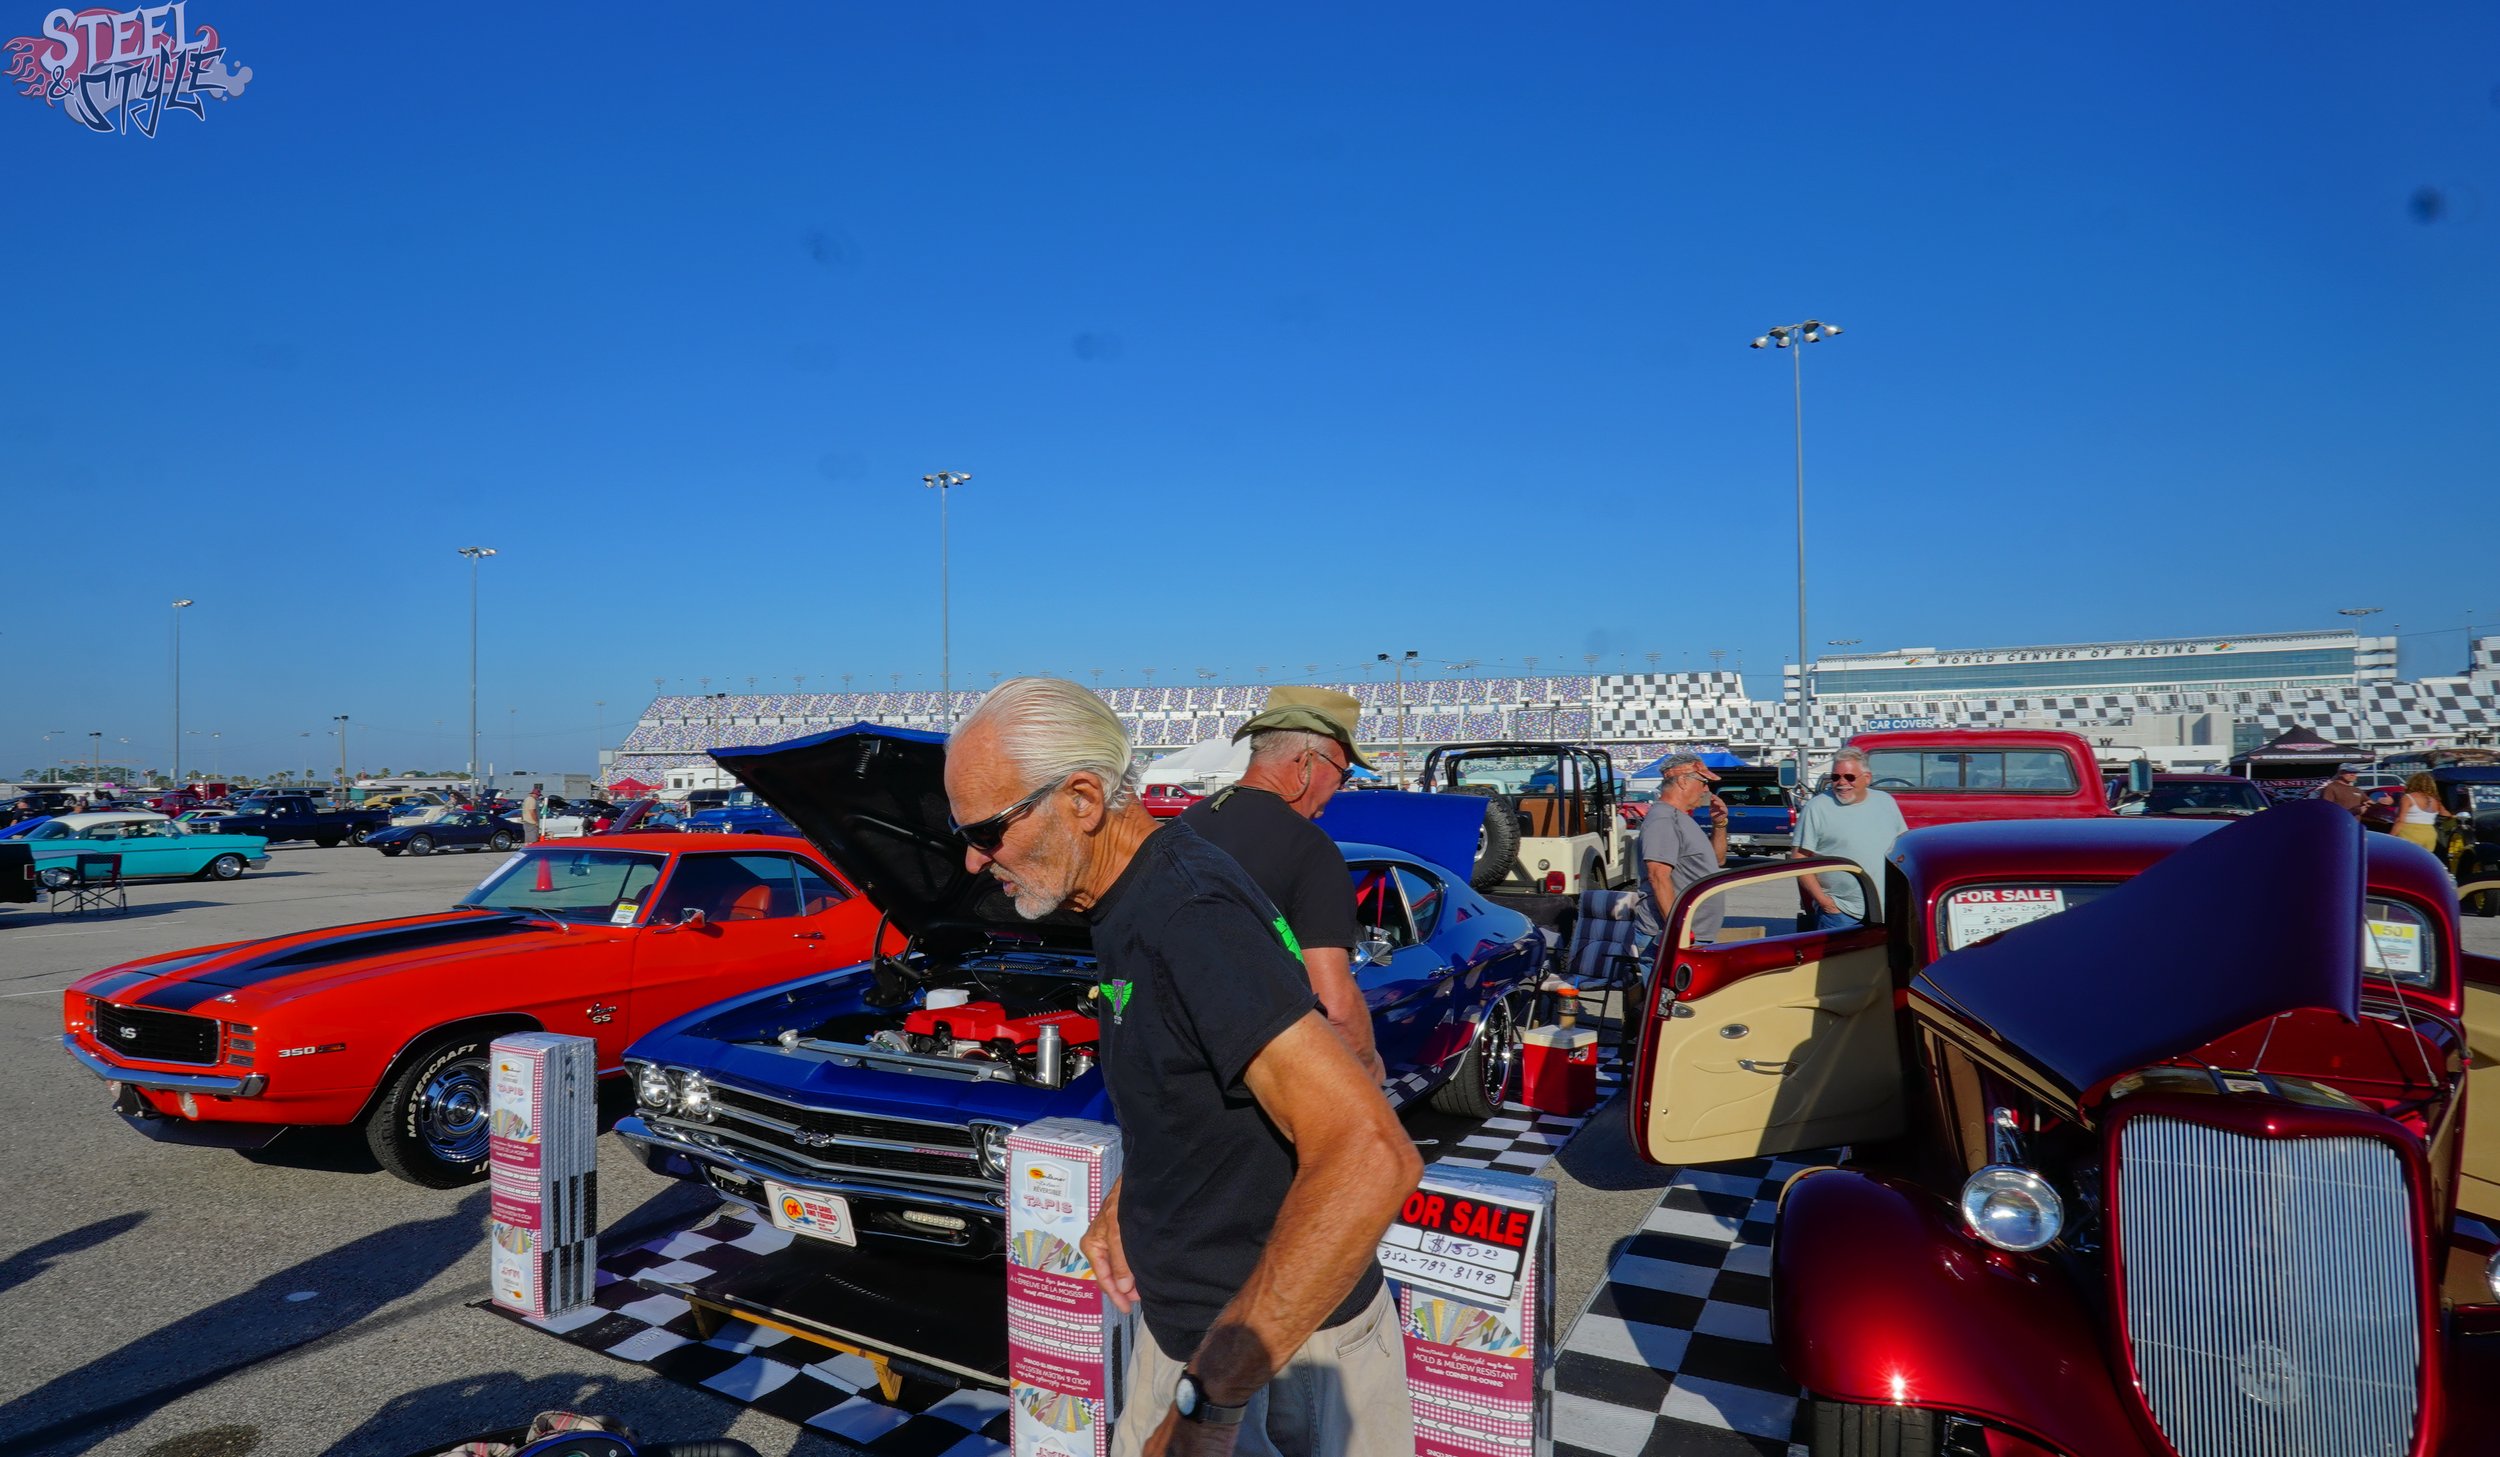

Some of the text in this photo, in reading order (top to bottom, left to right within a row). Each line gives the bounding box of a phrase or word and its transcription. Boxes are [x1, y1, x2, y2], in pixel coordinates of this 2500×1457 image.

[1937, 645, 2198, 665] WORLD CENTER OF RACING
[1868, 718, 1934, 730] CAR COVERS
[1956, 889, 2053, 902] FOR SALE
[2383, 925, 2403, 937] 50
[592, 1013, 611, 1024] SS
[278, 1046, 316, 1058] 350
[407, 1043, 478, 1138] MASTERCRAFT
[787, 1202, 801, 1216] OK
[1024, 1194, 1073, 1214] TAPIS
[1402, 1191, 1528, 1247] OR SALE
[1412, 1352, 1519, 1381] MOLD & MILDEW RESISTANT
